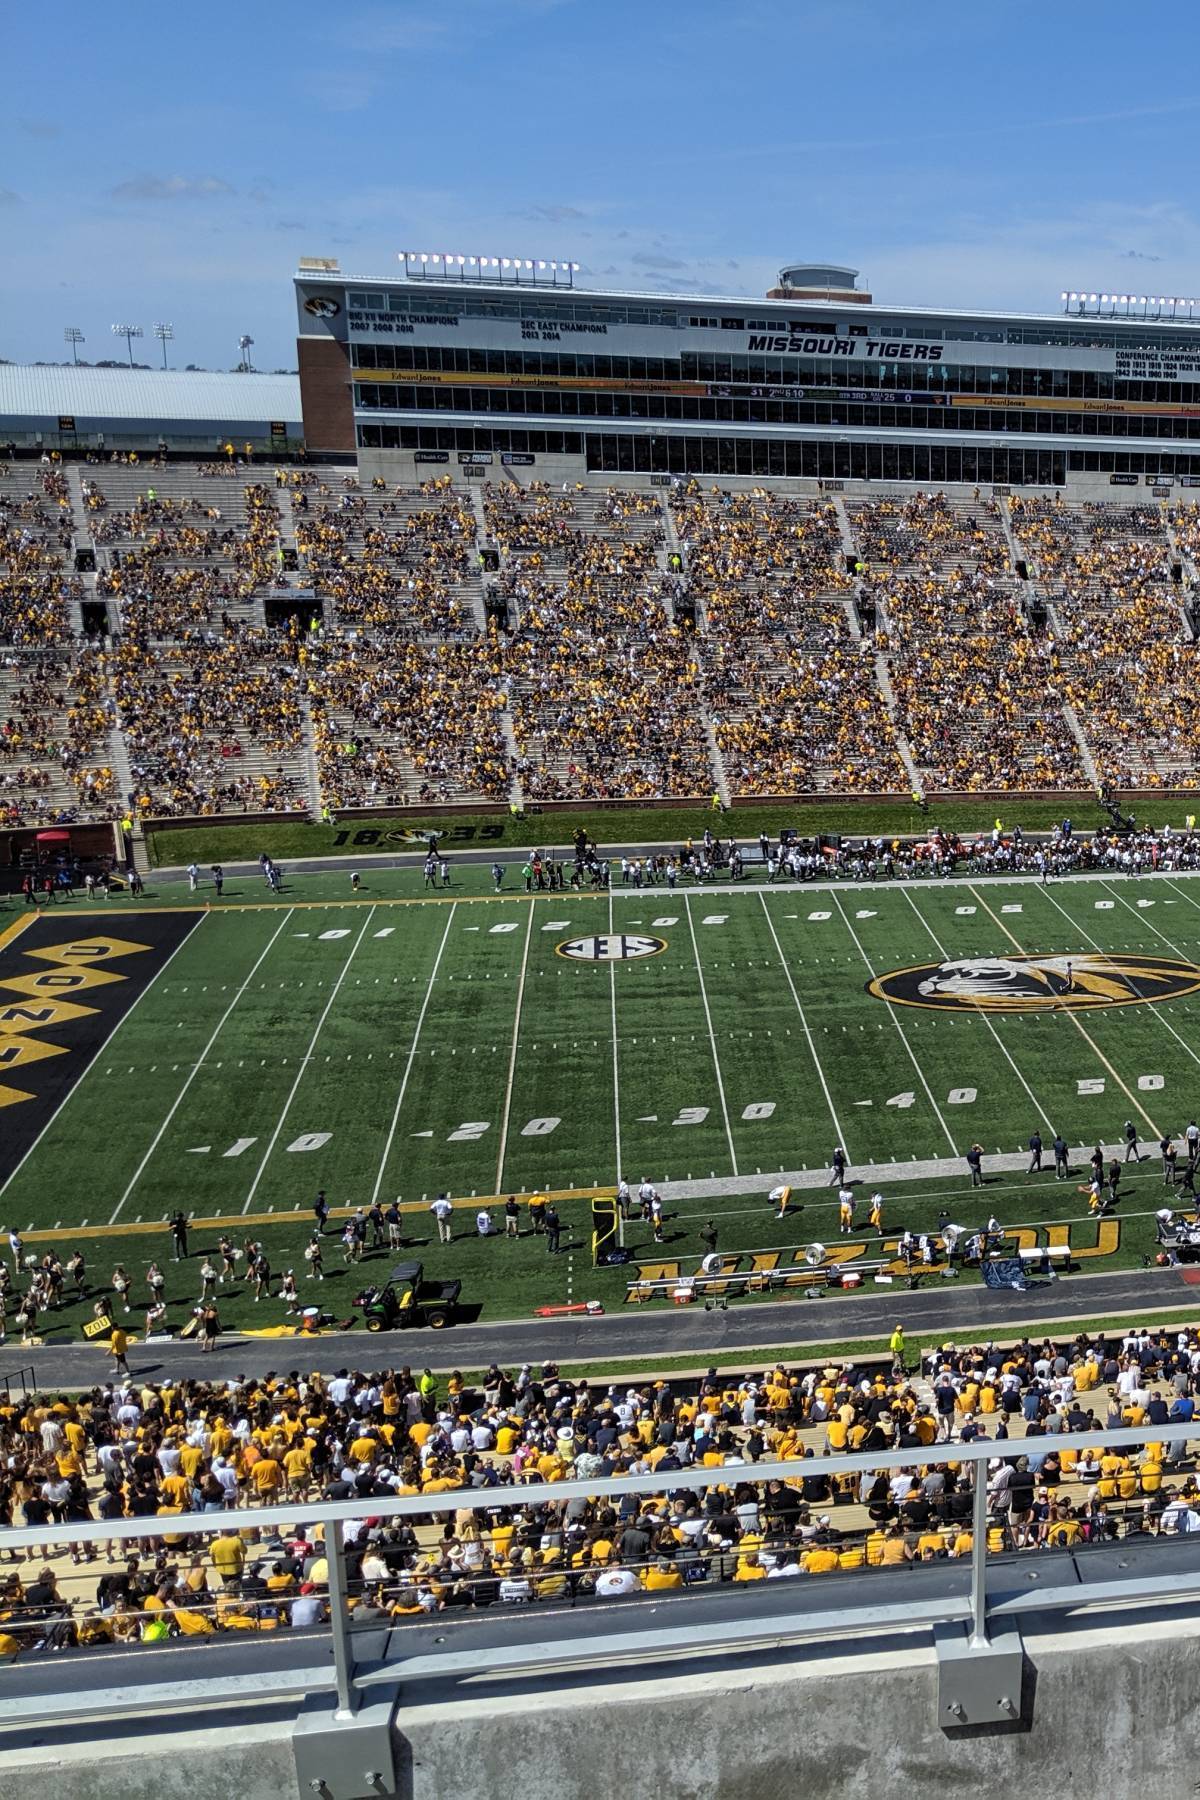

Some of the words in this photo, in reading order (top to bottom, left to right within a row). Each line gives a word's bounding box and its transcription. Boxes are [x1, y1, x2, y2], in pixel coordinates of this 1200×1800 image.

[349, 311, 363, 321] BIG
[378, 313, 407, 323] NORTH
[408, 315, 459, 326] CHAMPIONS
[521, 320, 536, 330] SEC
[538, 321, 557, 331] EAST
[560, 323, 608, 334] CHAMPIONS
[521, 331, 539, 340] 2013
[542, 331, 560, 341] 2014
[748, 335, 857, 355] MISSOURI
[866, 341, 944, 360] TIGERS
[1115, 351, 1158, 361] CONFERENCE
[1160, 354, 1200, 363] CHAMPIONS
[904, 394, 912, 403] 0
[85, 1316, 108, 1335] ZOU
